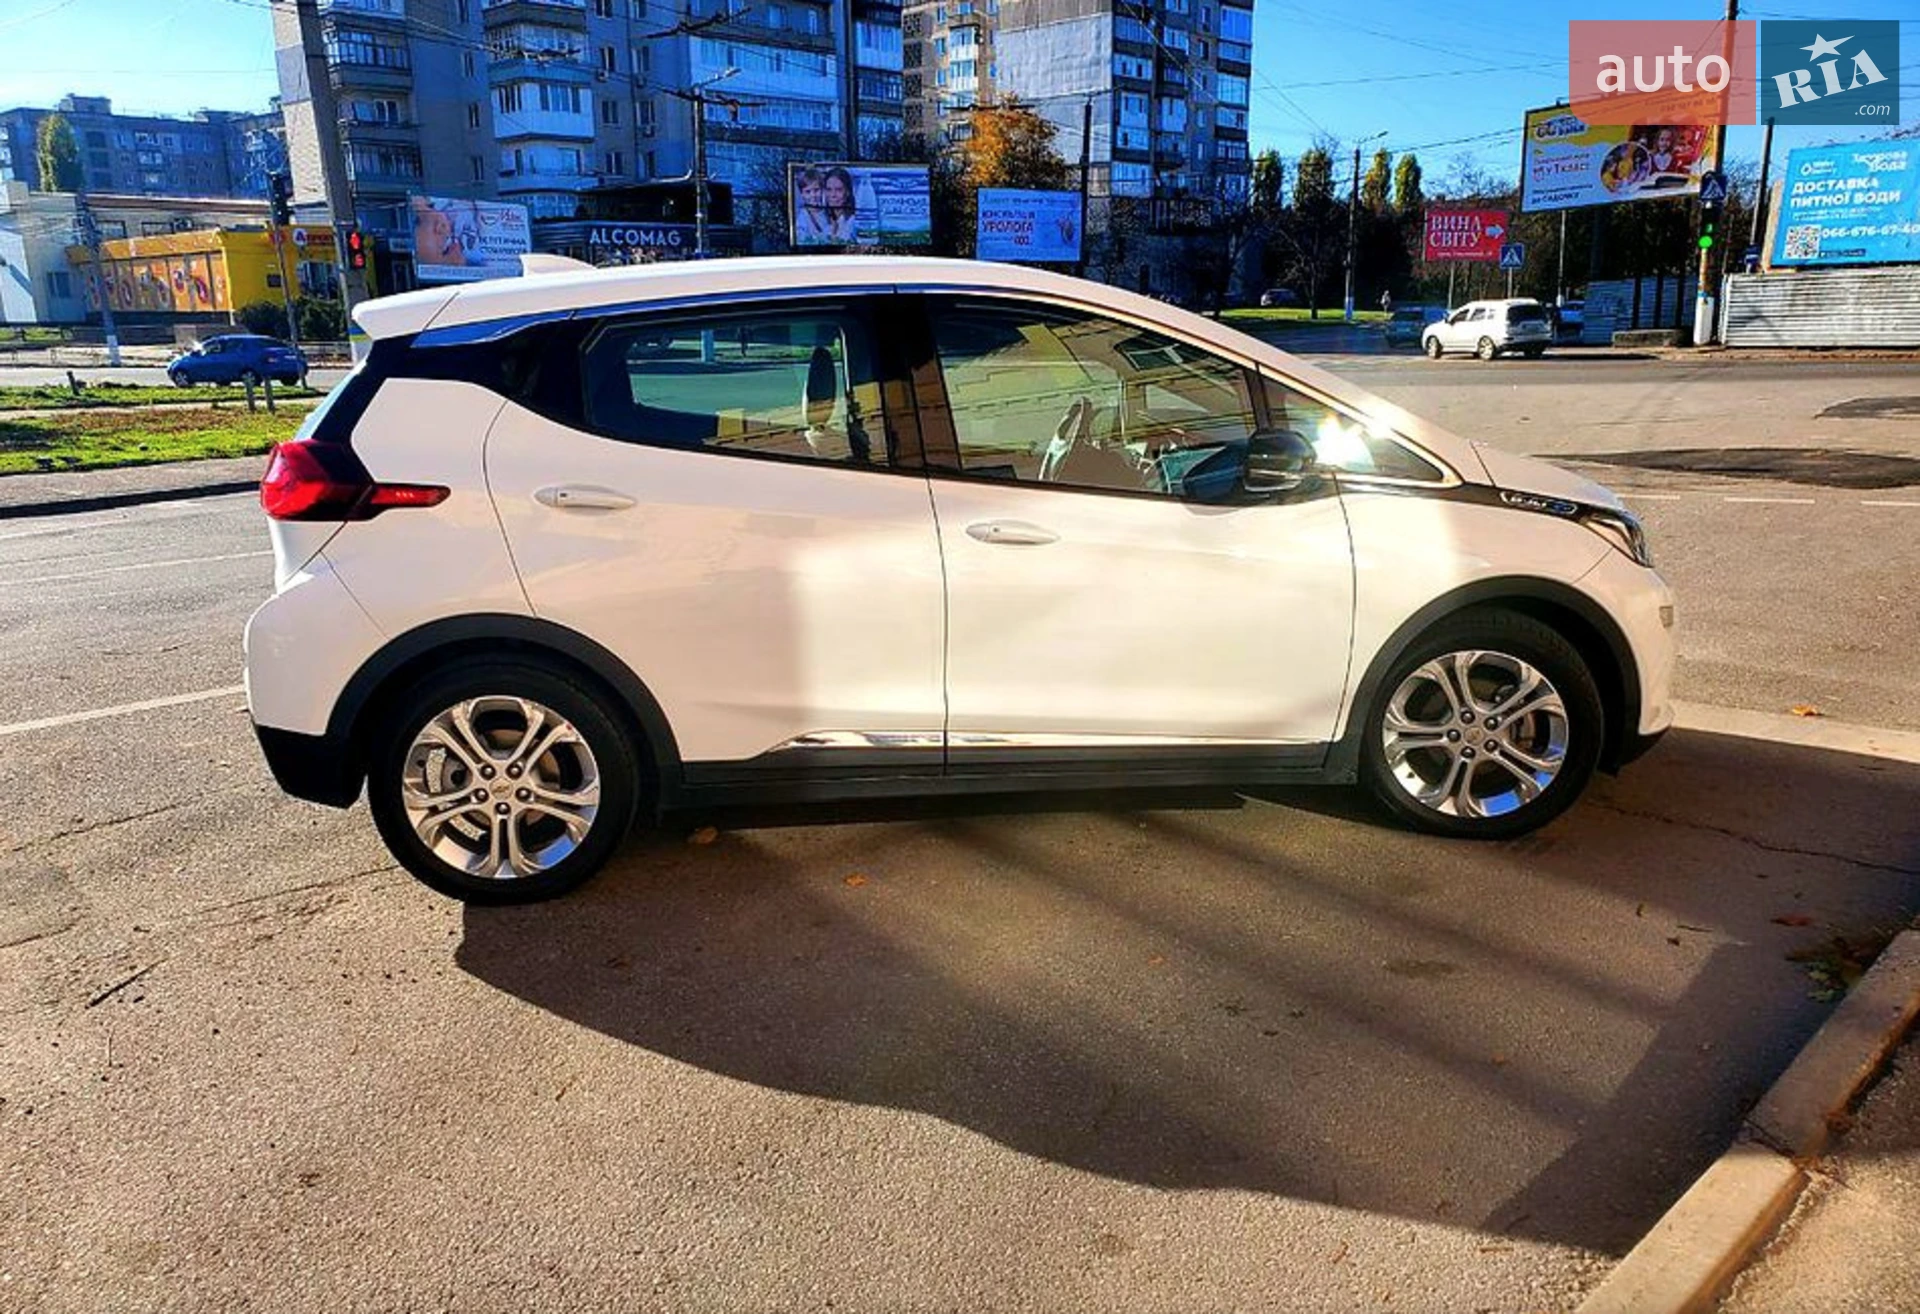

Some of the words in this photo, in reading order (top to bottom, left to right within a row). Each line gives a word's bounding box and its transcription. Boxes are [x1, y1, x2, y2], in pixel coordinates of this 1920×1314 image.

[1793, 179, 1879, 194] ДОСТАВКА
[1791, 192, 1850, 208] ПИТНОЇ
[1854, 190, 1901, 204] ВОДИ
[982, 221, 1033, 233] УРОЛОГА
[1431, 215, 1482, 231] ВИНА
[589, 228, 681, 246] ALCOMAG
[1429, 232, 1481, 248] СВІТУ
